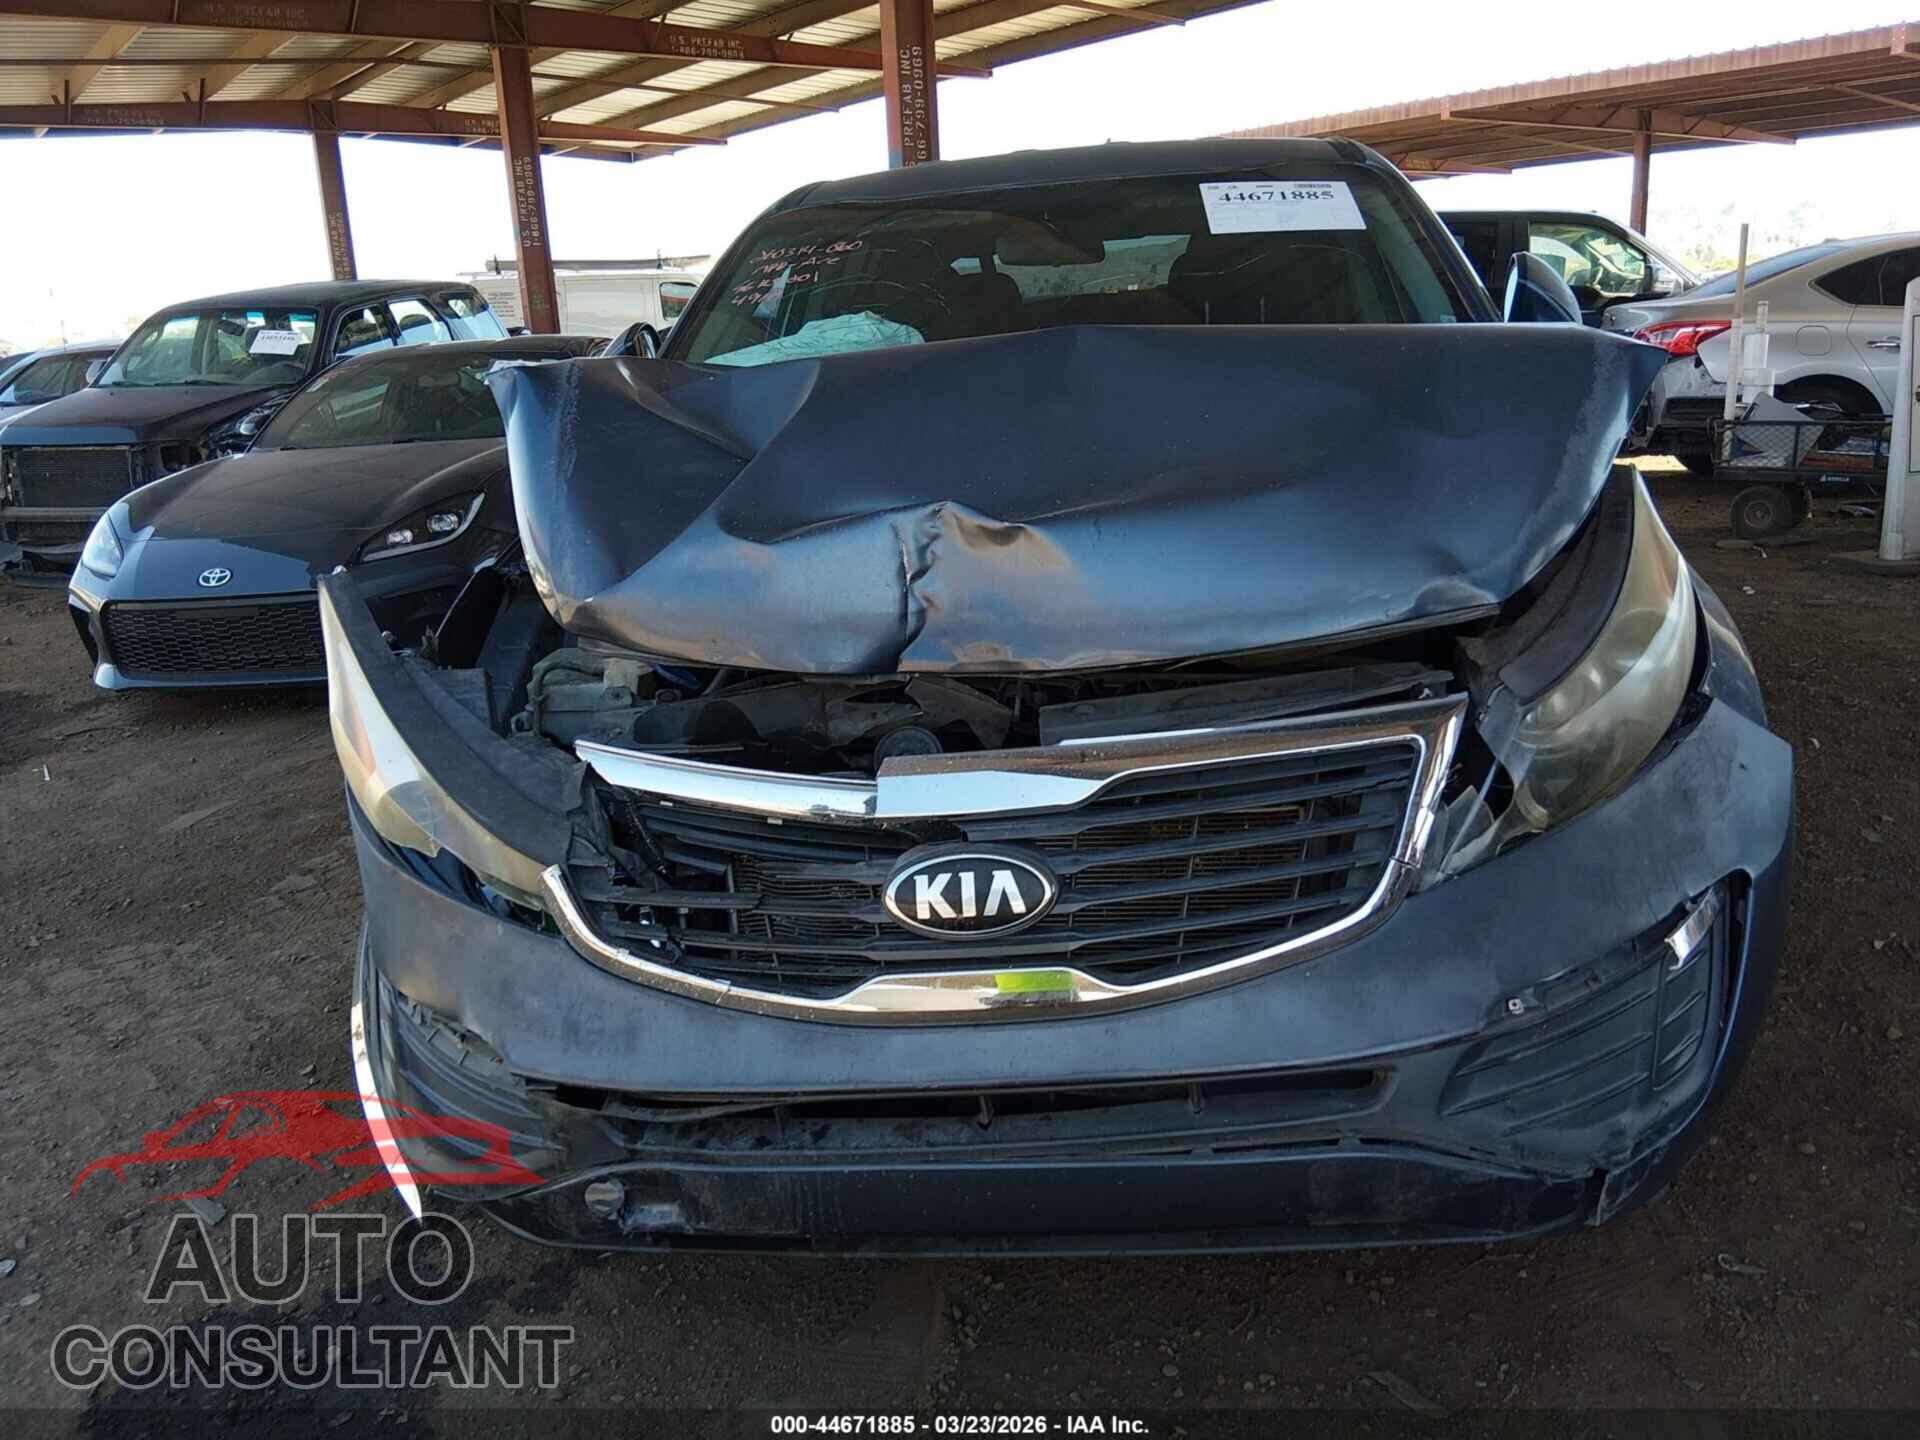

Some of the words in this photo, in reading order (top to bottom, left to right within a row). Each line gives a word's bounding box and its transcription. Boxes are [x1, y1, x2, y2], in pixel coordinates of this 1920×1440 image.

[900, 43, 911, 75] INC.
[902, 83, 914, 147] PREFAB
[1219, 191, 1335, 202] 44671885
[913, 870, 1027, 920] KIA
